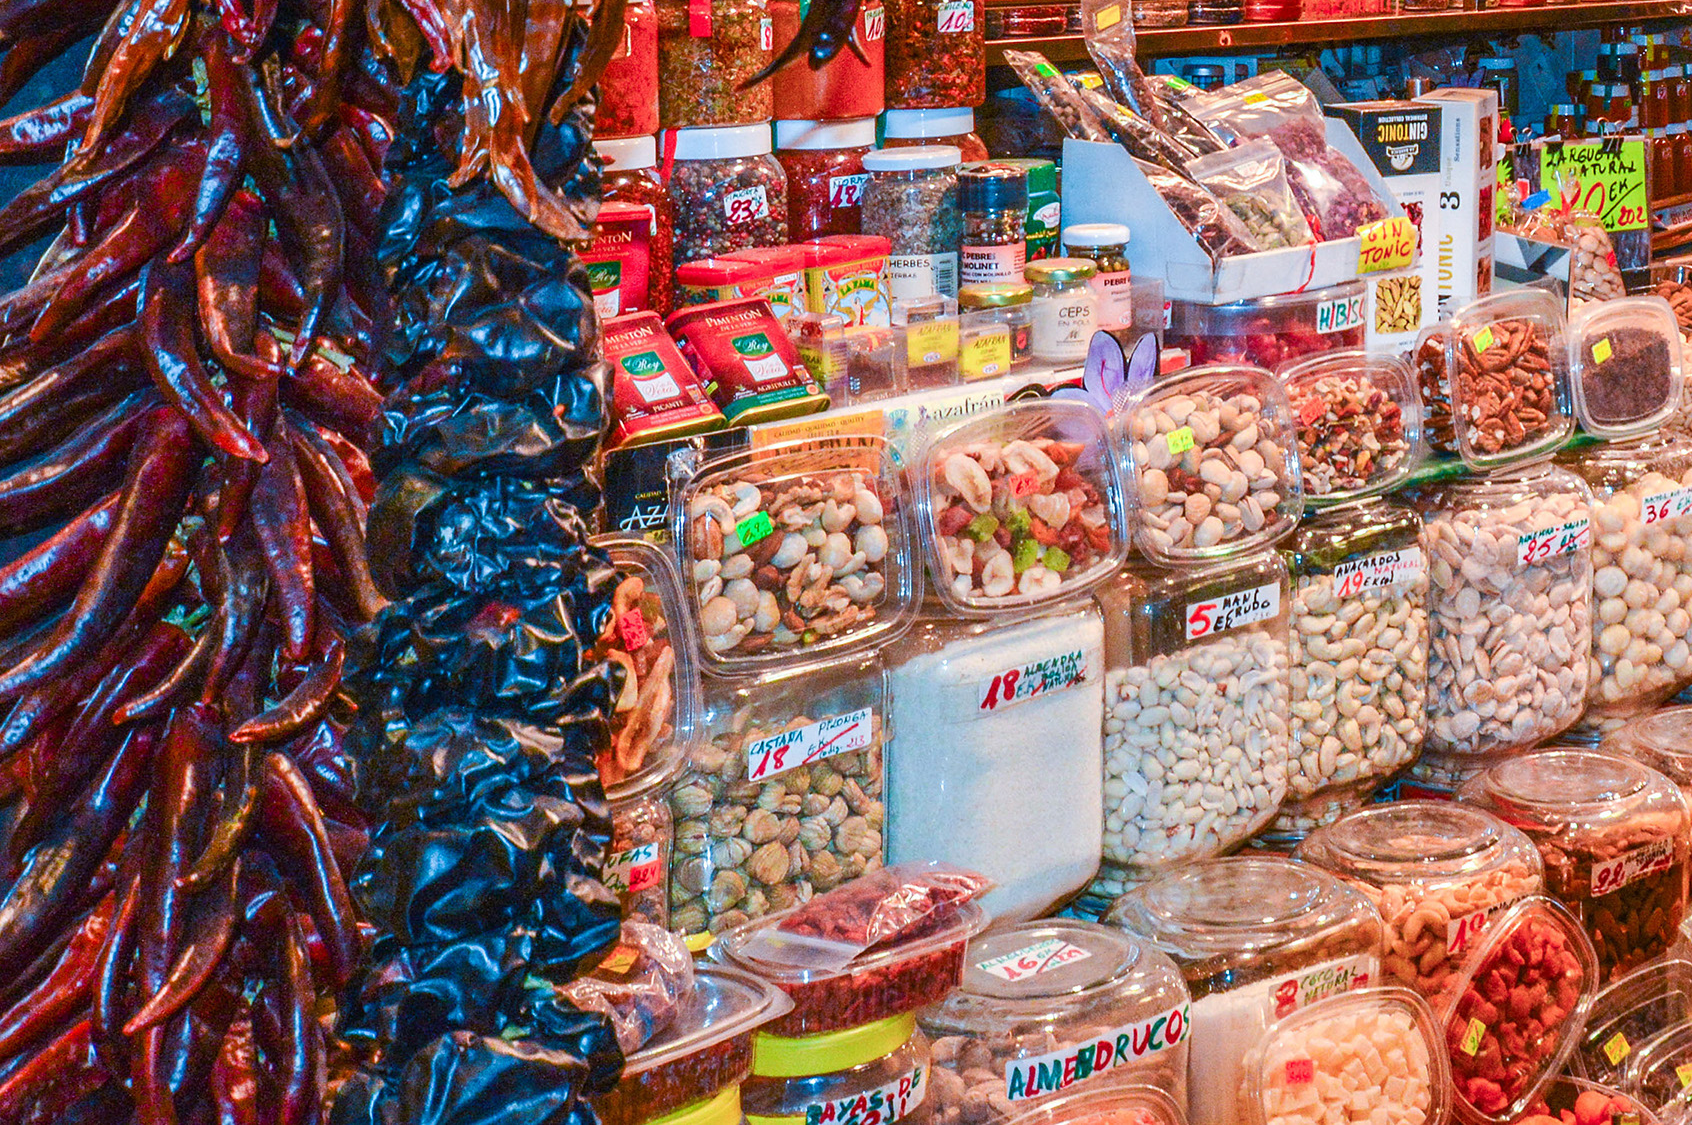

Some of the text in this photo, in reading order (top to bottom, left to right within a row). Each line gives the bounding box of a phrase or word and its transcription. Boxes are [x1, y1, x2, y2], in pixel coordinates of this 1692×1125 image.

[1377, 121, 1428, 143] GINTONIC
[1439, 191, 1461, 211] 3
[1367, 220, 1403, 243] GIN
[889, 258, 931, 269] HERBES
[1360, 241, 1412, 265] TONIC
[839, 277, 875, 297] LA FAMA
[703, 308, 764, 328] PIMENTÓN
[1058, 306, 1090, 318] CEPS
[604, 325, 655, 345] MENTÓN
[757, 378, 798, 392] AGRIDULCE
[652, 400, 685, 413] PICANTE
[931, 392, 1003, 422] azafrán
[1645, 500, 1672, 525] 36
[1338, 570, 1364, 597] 19
[1188, 604, 1217, 636] 5
[980, 668, 1021, 710] 18
[751, 744, 791, 779] 18
[606, 844, 653, 868] UFAS
[1007, 1002, 1191, 1101] ALMENDRUCOS
